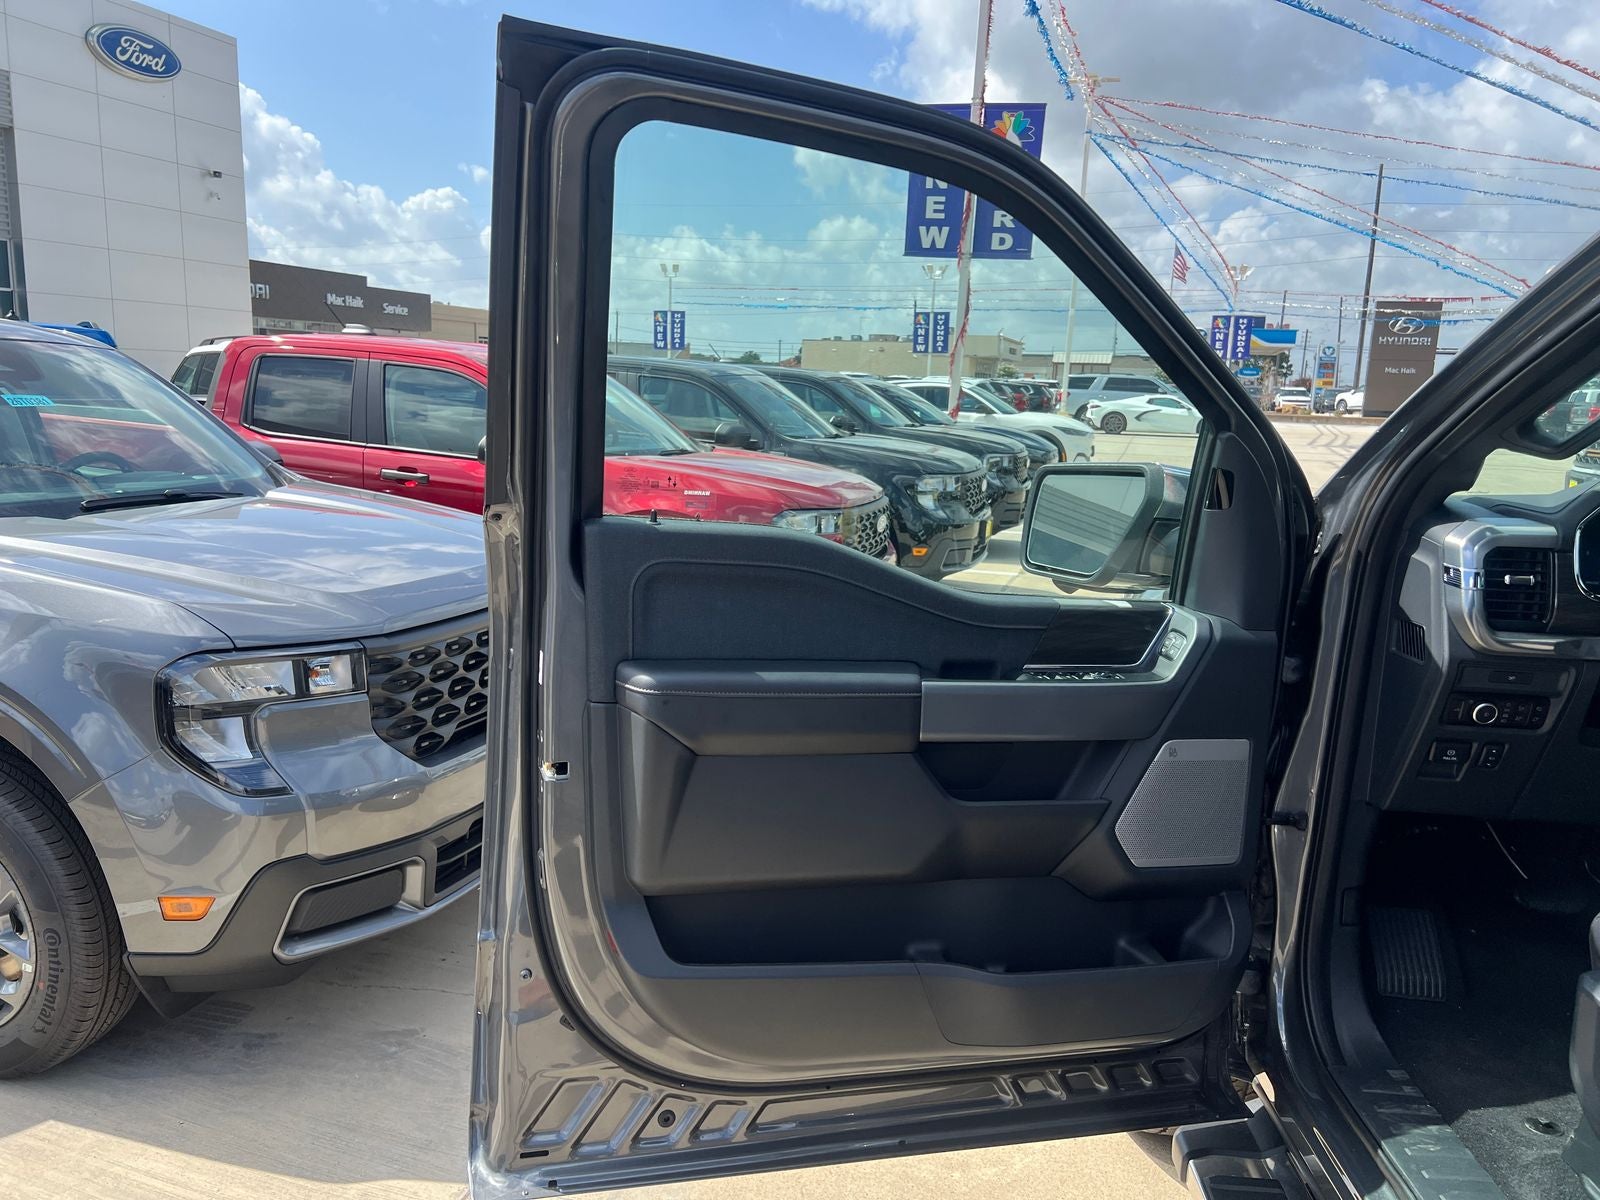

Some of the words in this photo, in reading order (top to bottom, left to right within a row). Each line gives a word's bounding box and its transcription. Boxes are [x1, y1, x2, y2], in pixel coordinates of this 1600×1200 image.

[116, 36, 166, 72] Ford
[991, 210, 1016, 250] RD
[326, 293, 344, 306] Mac
[345, 295, 364, 308] Haik
[382, 302, 409, 316] Service
[656, 326, 665, 348] NEW
[916, 328, 926, 352] NEW
[936, 314, 945, 352] HYUNDAI
[1236, 318, 1247, 358] HYUNDAI
[1379, 336, 1431, 346] HYUNDAI
[38, 927, 62, 1026] Continental
